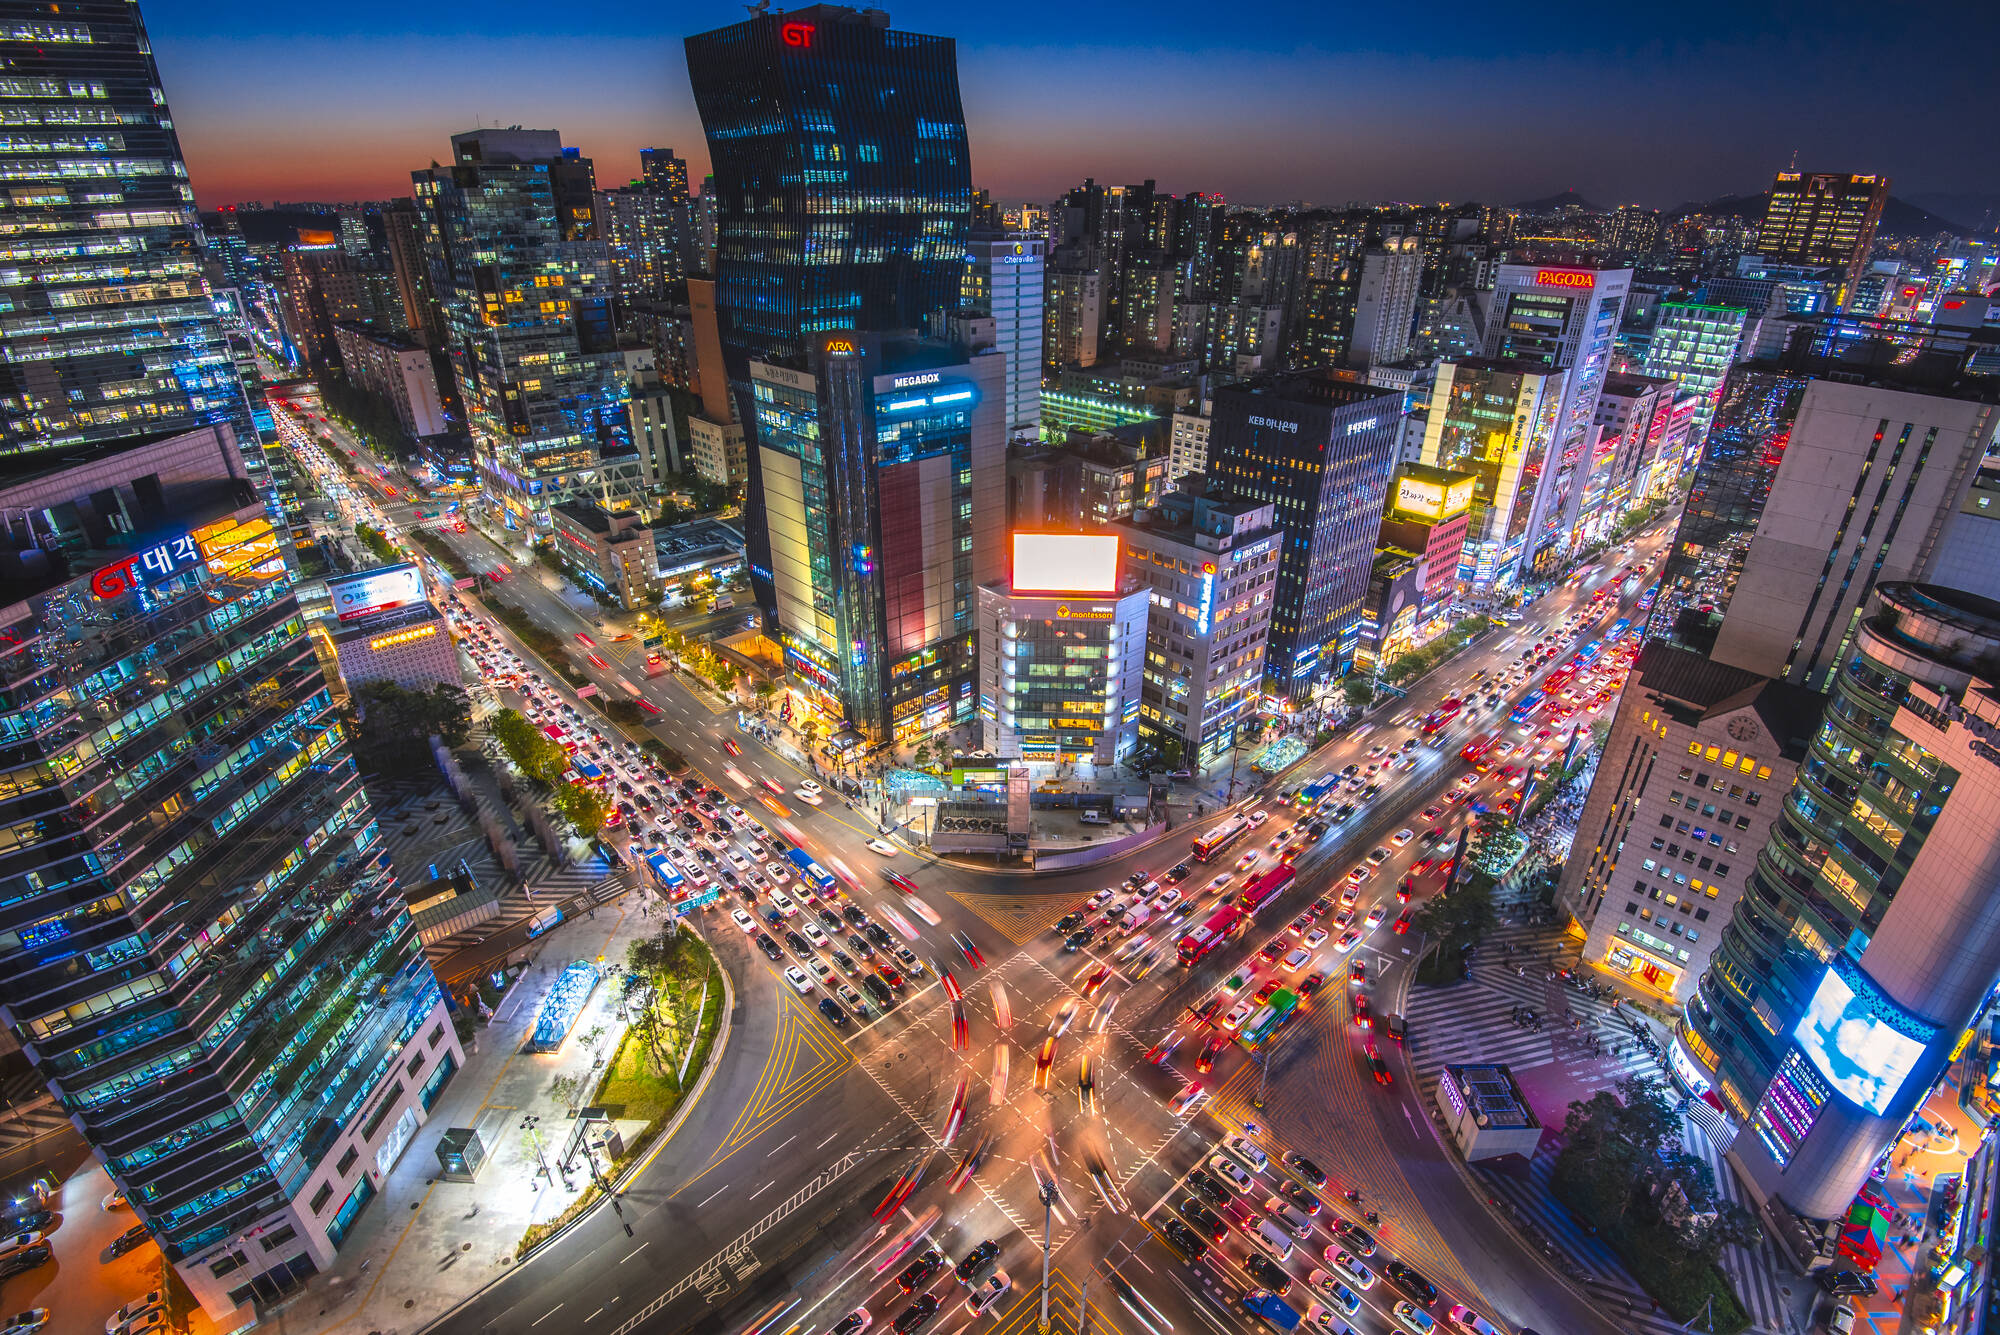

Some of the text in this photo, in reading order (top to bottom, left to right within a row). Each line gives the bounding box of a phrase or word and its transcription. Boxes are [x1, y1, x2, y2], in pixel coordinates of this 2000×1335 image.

[782, 22, 816, 47] GT
[1538, 271, 1593, 287] PAGODA
[827, 342, 853, 352] ARA
[894, 373, 940, 388] MEGABOX
[1248, 415, 1298, 434] KEB 하나은행
[92, 555, 140, 599] GT
[142, 535, 198, 574] 대각
